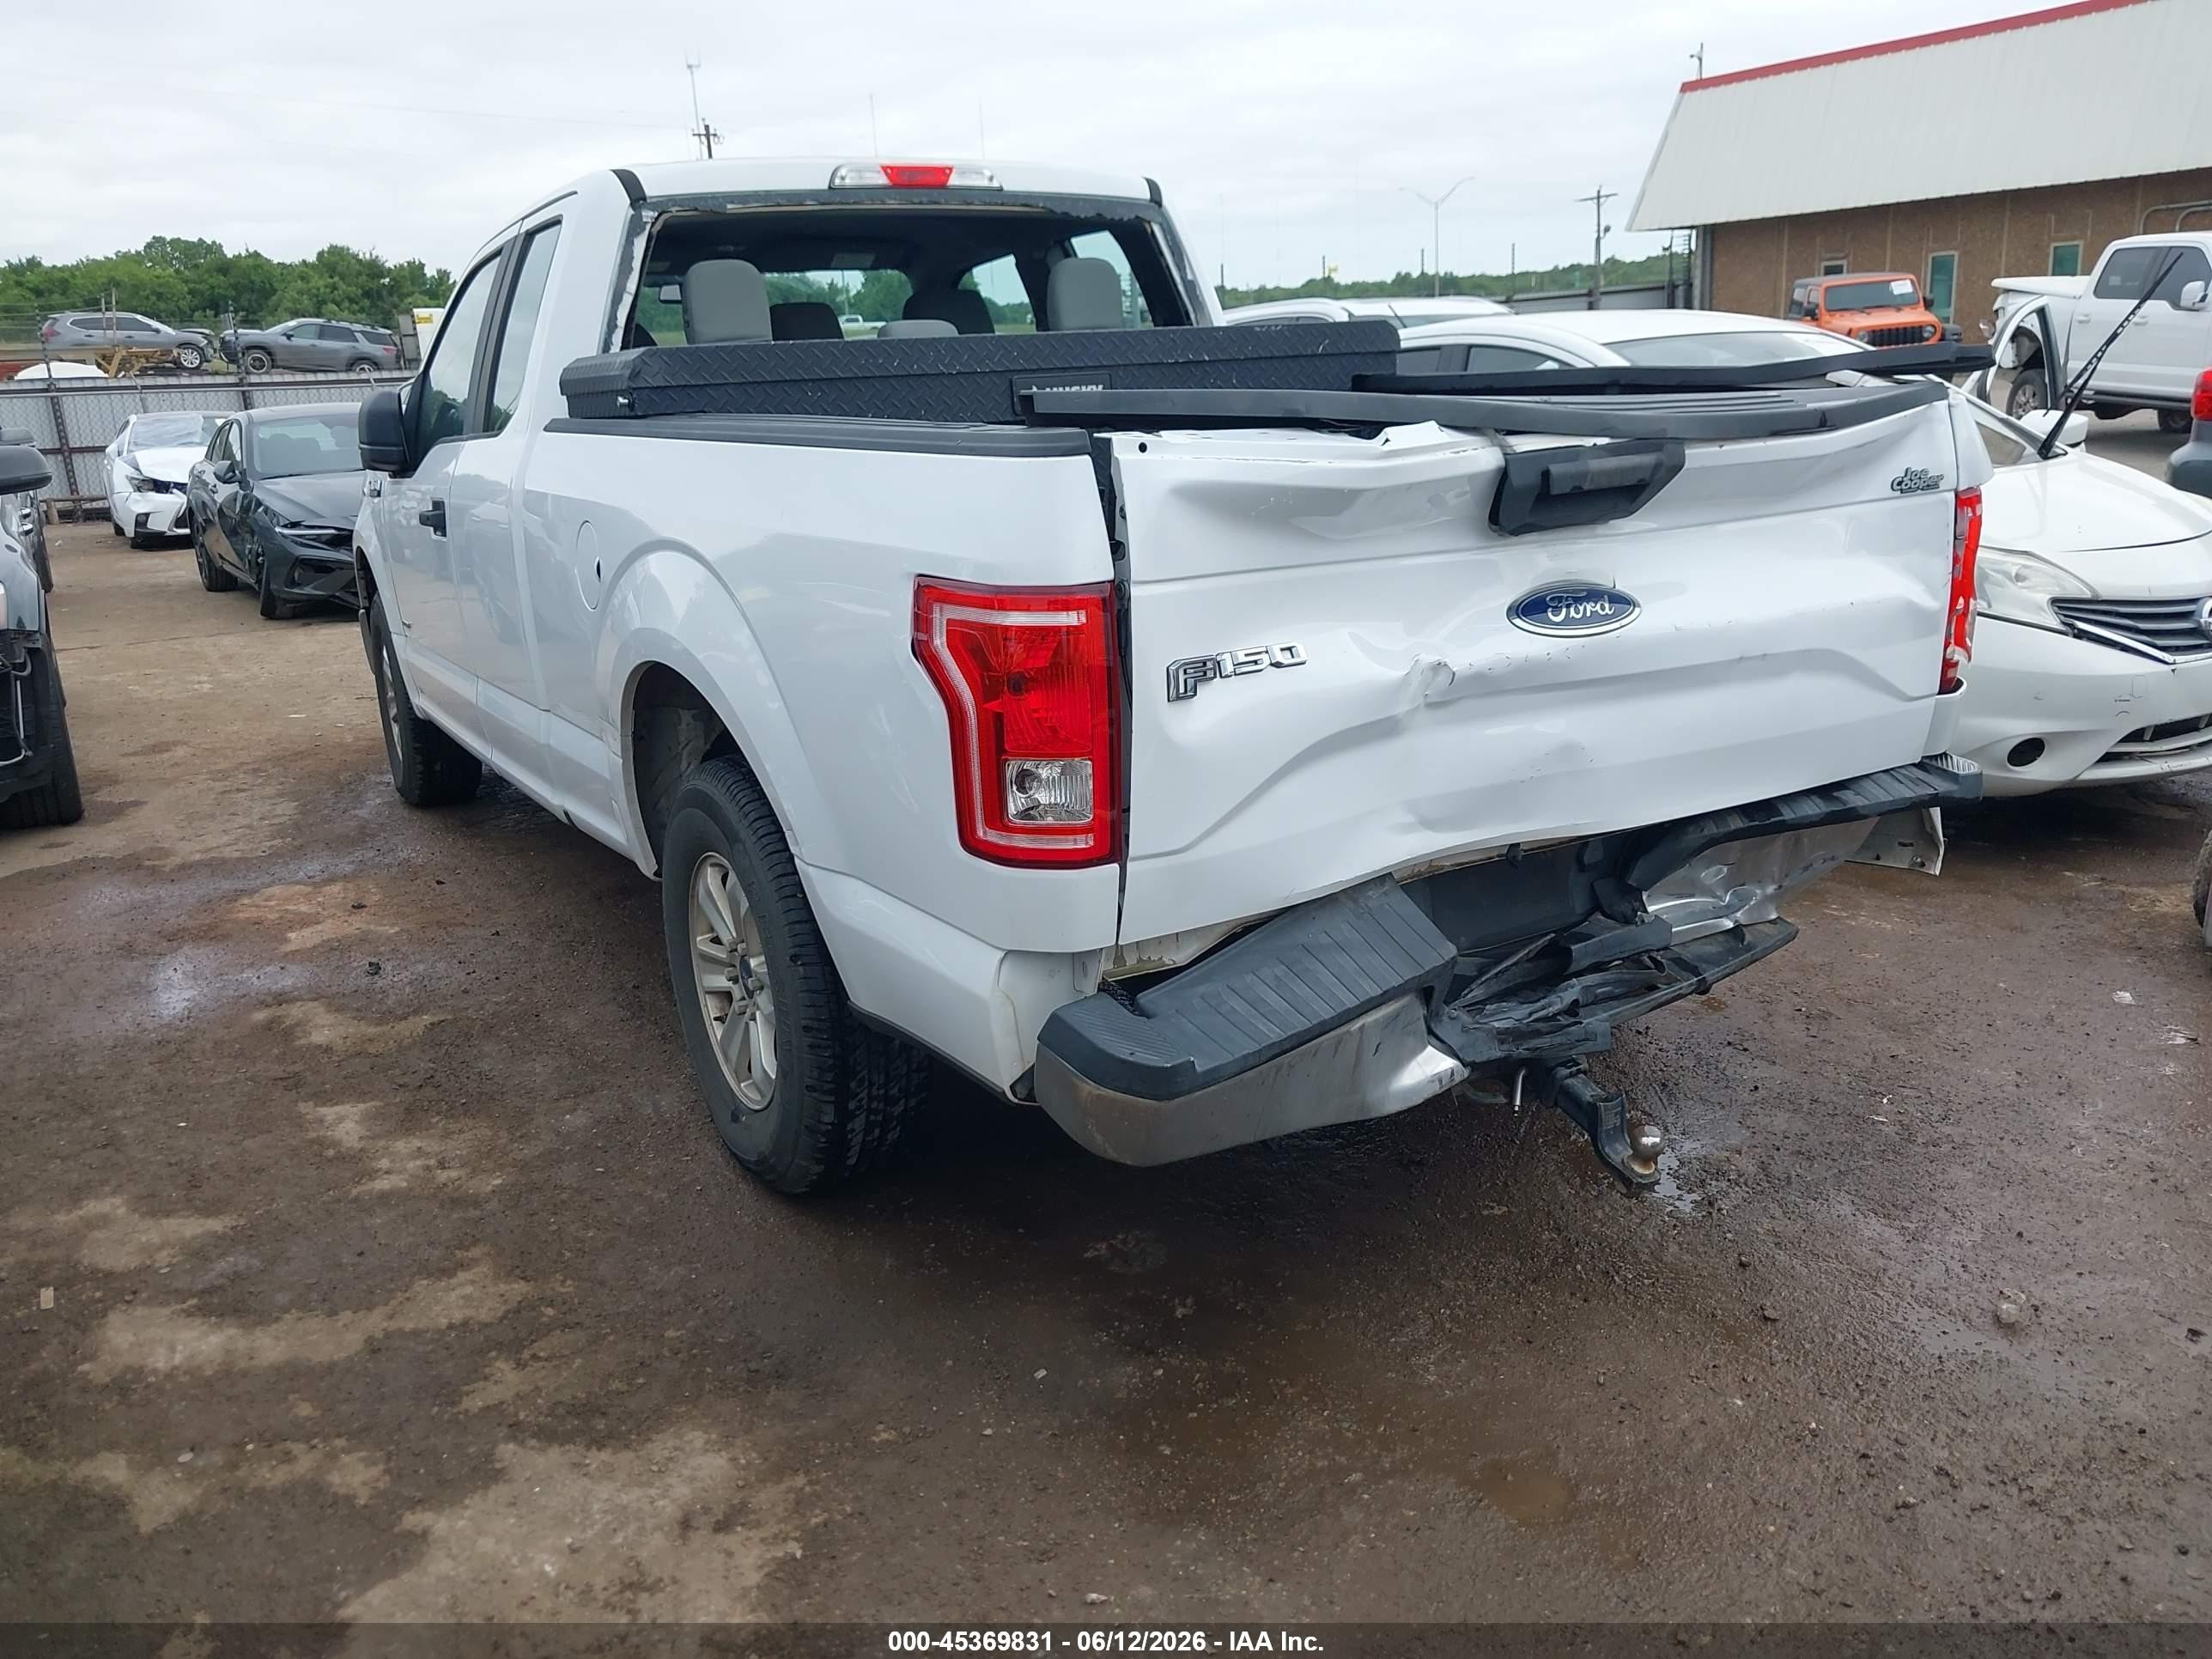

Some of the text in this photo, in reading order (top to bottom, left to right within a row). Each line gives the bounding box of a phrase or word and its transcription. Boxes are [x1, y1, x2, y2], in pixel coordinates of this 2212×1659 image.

[1891, 474, 1944, 491] Cooper
[1905, 467, 1930, 481] Joe
[1547, 591, 1615, 623] Ford
[1166, 641, 1309, 702] F150
